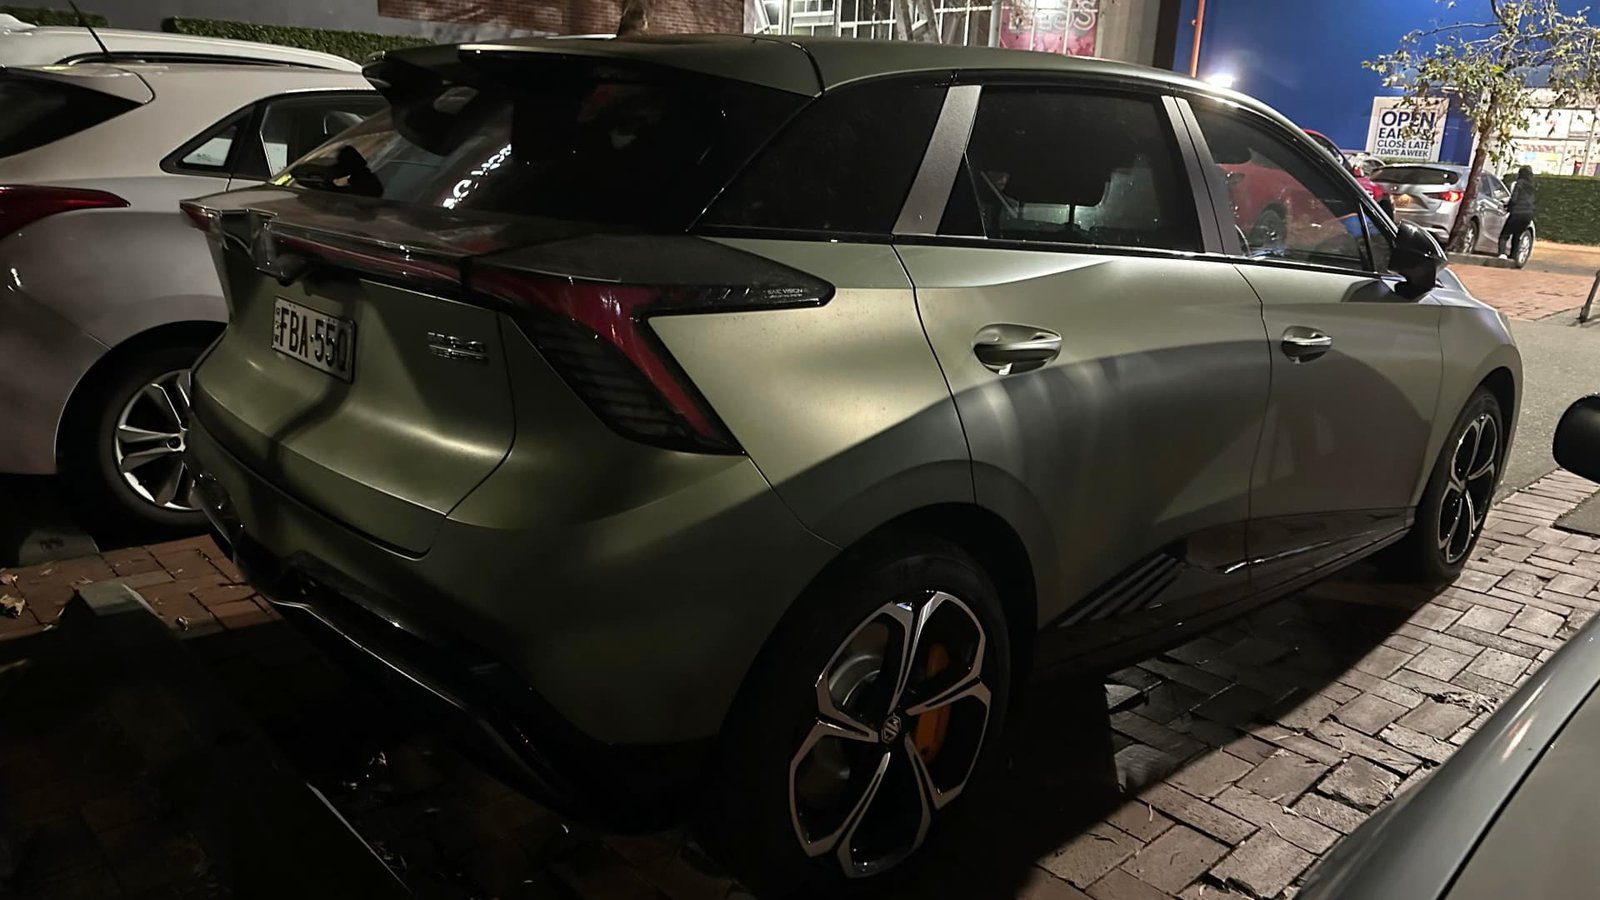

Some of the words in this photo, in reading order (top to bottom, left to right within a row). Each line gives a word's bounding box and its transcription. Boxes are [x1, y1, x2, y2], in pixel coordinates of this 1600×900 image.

[1381, 111, 1436, 129] OPEN
[1378, 128, 1420, 139] EARY
[1377, 140, 1407, 148] CLOSE
[1408, 141, 1430, 149] LATE
